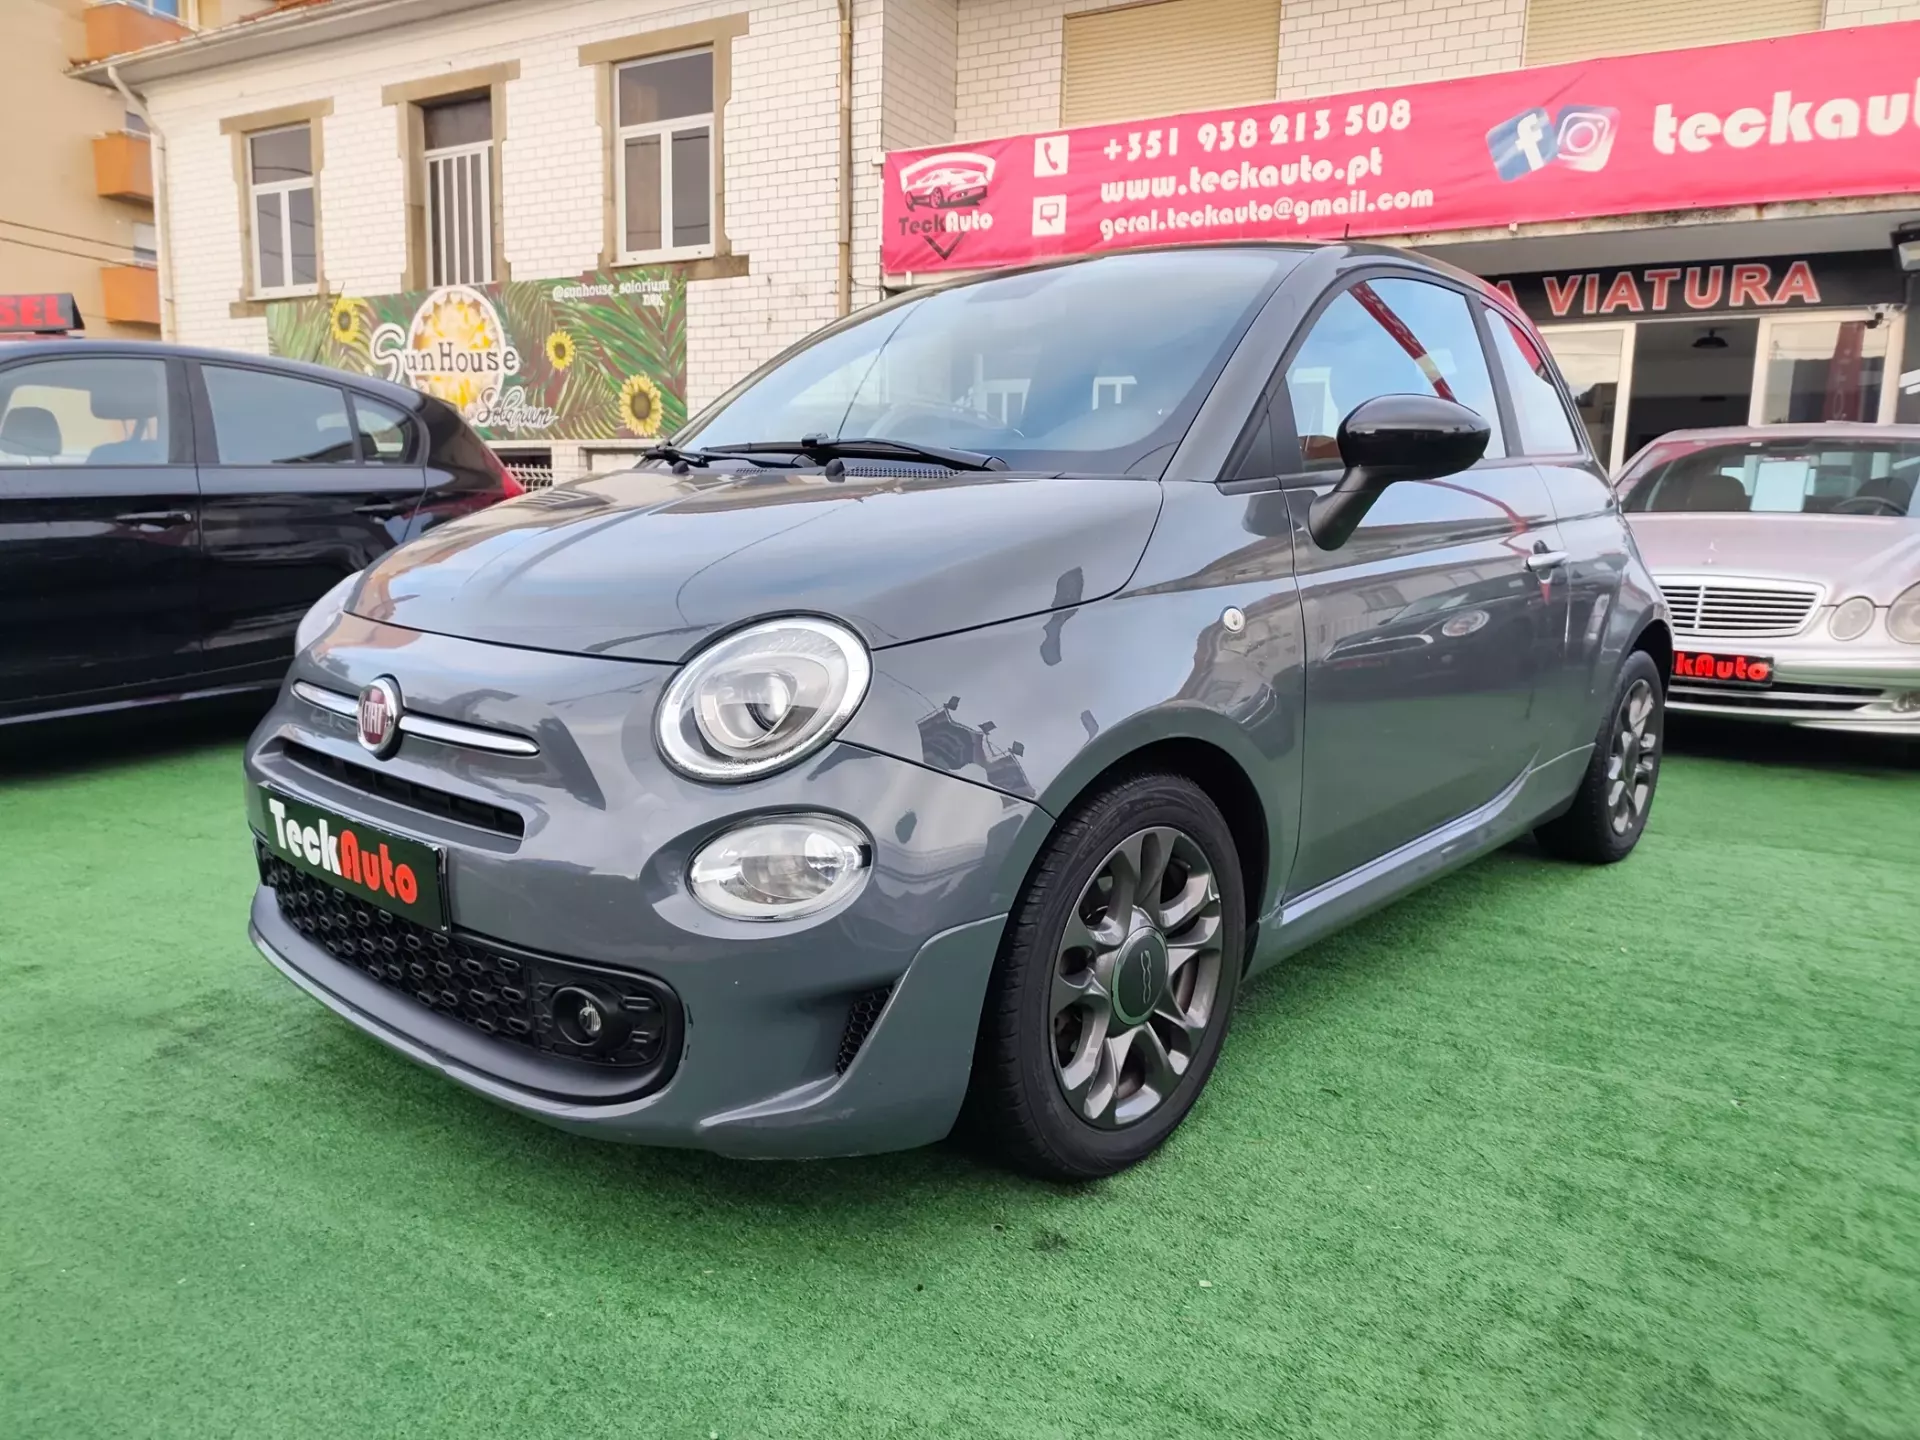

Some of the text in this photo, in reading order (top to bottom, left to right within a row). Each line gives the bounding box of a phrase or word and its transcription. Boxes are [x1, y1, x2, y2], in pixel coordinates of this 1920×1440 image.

[1103, 99, 1411, 161] +351 938 213 508
[1101, 147, 1383, 203] www.teckauto.pt
[899, 209, 993, 236] TeckAuto
[1100, 189, 1434, 242] geral.teckauto@gmail.com
[1543, 261, 1822, 316] VIATURA
[364, 701, 385, 735] FIAT
[269, 798, 418, 904] TeckAuto
